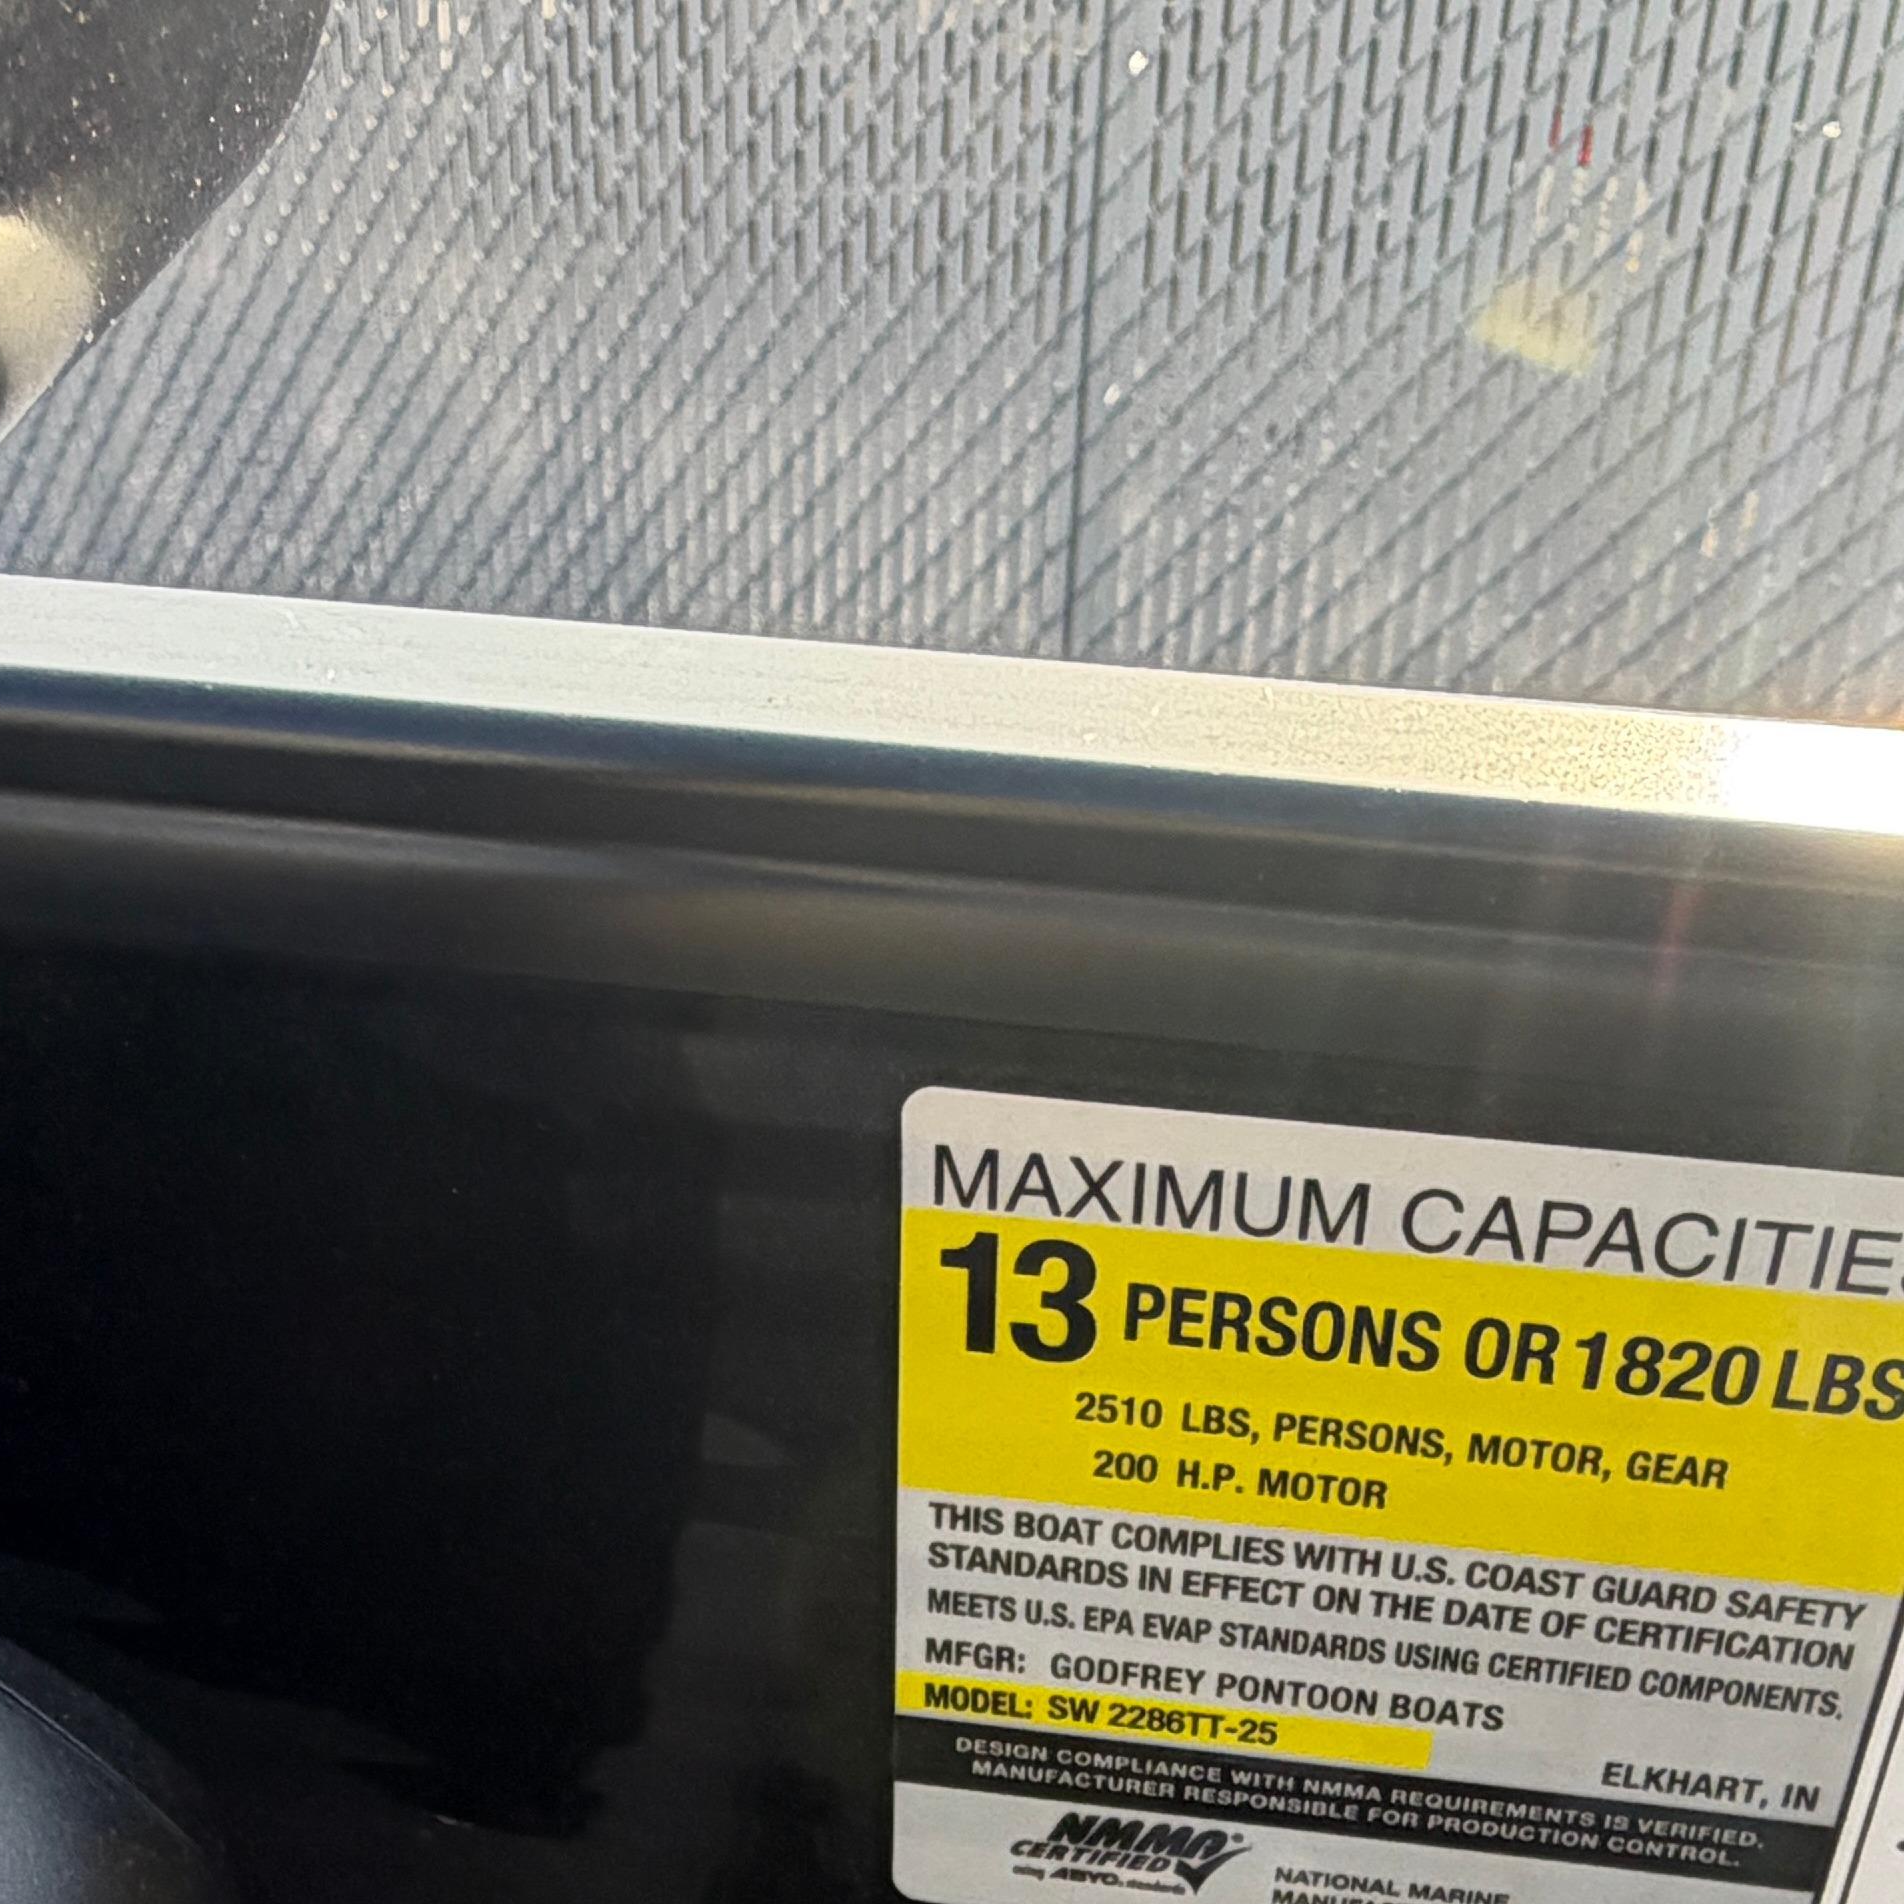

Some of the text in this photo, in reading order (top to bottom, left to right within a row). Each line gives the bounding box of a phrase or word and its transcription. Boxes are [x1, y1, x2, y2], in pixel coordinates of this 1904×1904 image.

[933, 1143, 1372, 1246] MAXIMUM
[939, 1231, 1098, 1364] 13
[1123, 1282, 1442, 1373] PERSONS
[1464, 1316, 1561, 1386] OR
[1575, 1330, 1761, 1406] 1820
[1075, 1391, 1729, 1490] 2510 LBS, PERSONS, MOTOR, GEAR
[1092, 1449, 1389, 1510] 200 H.P. MOTOR
[927, 1540, 1856, 1672] STANDARDS IN EFFECT ON THE DATE OF CERTIFICATION
[928, 1501, 1868, 1632] THIS BOAT COMPLIES WITH U.S. COAST GUARD SAFETY
[924, 1636, 1505, 1732] MFGR: GODFREY PONTOON BOATS
[927, 1587, 1843, 1721] MEETS U.S. EPA EVAP STANDARDS USING CERTIFIED COMPONENTS.
[924, 1681, 1279, 1746] MODEL: SW 2286TT-25
[955, 1736, 1765, 1850] DESIGN COMPLIANCE WITH NMMA REQUIREMENTS IS VERIFIED.
[971, 1758, 1740, 1867] MANUFACTURER RESPONSIBLE FOR PRODUCTION CONTROL.
[1047, 1812, 1228, 1860] NMMA
[1600, 1761, 1821, 1812] ELKHART, IN
[1010, 1839, 1172, 1873] CERTIFIED
[1274, 1866, 1401, 1898] NATIONAL
